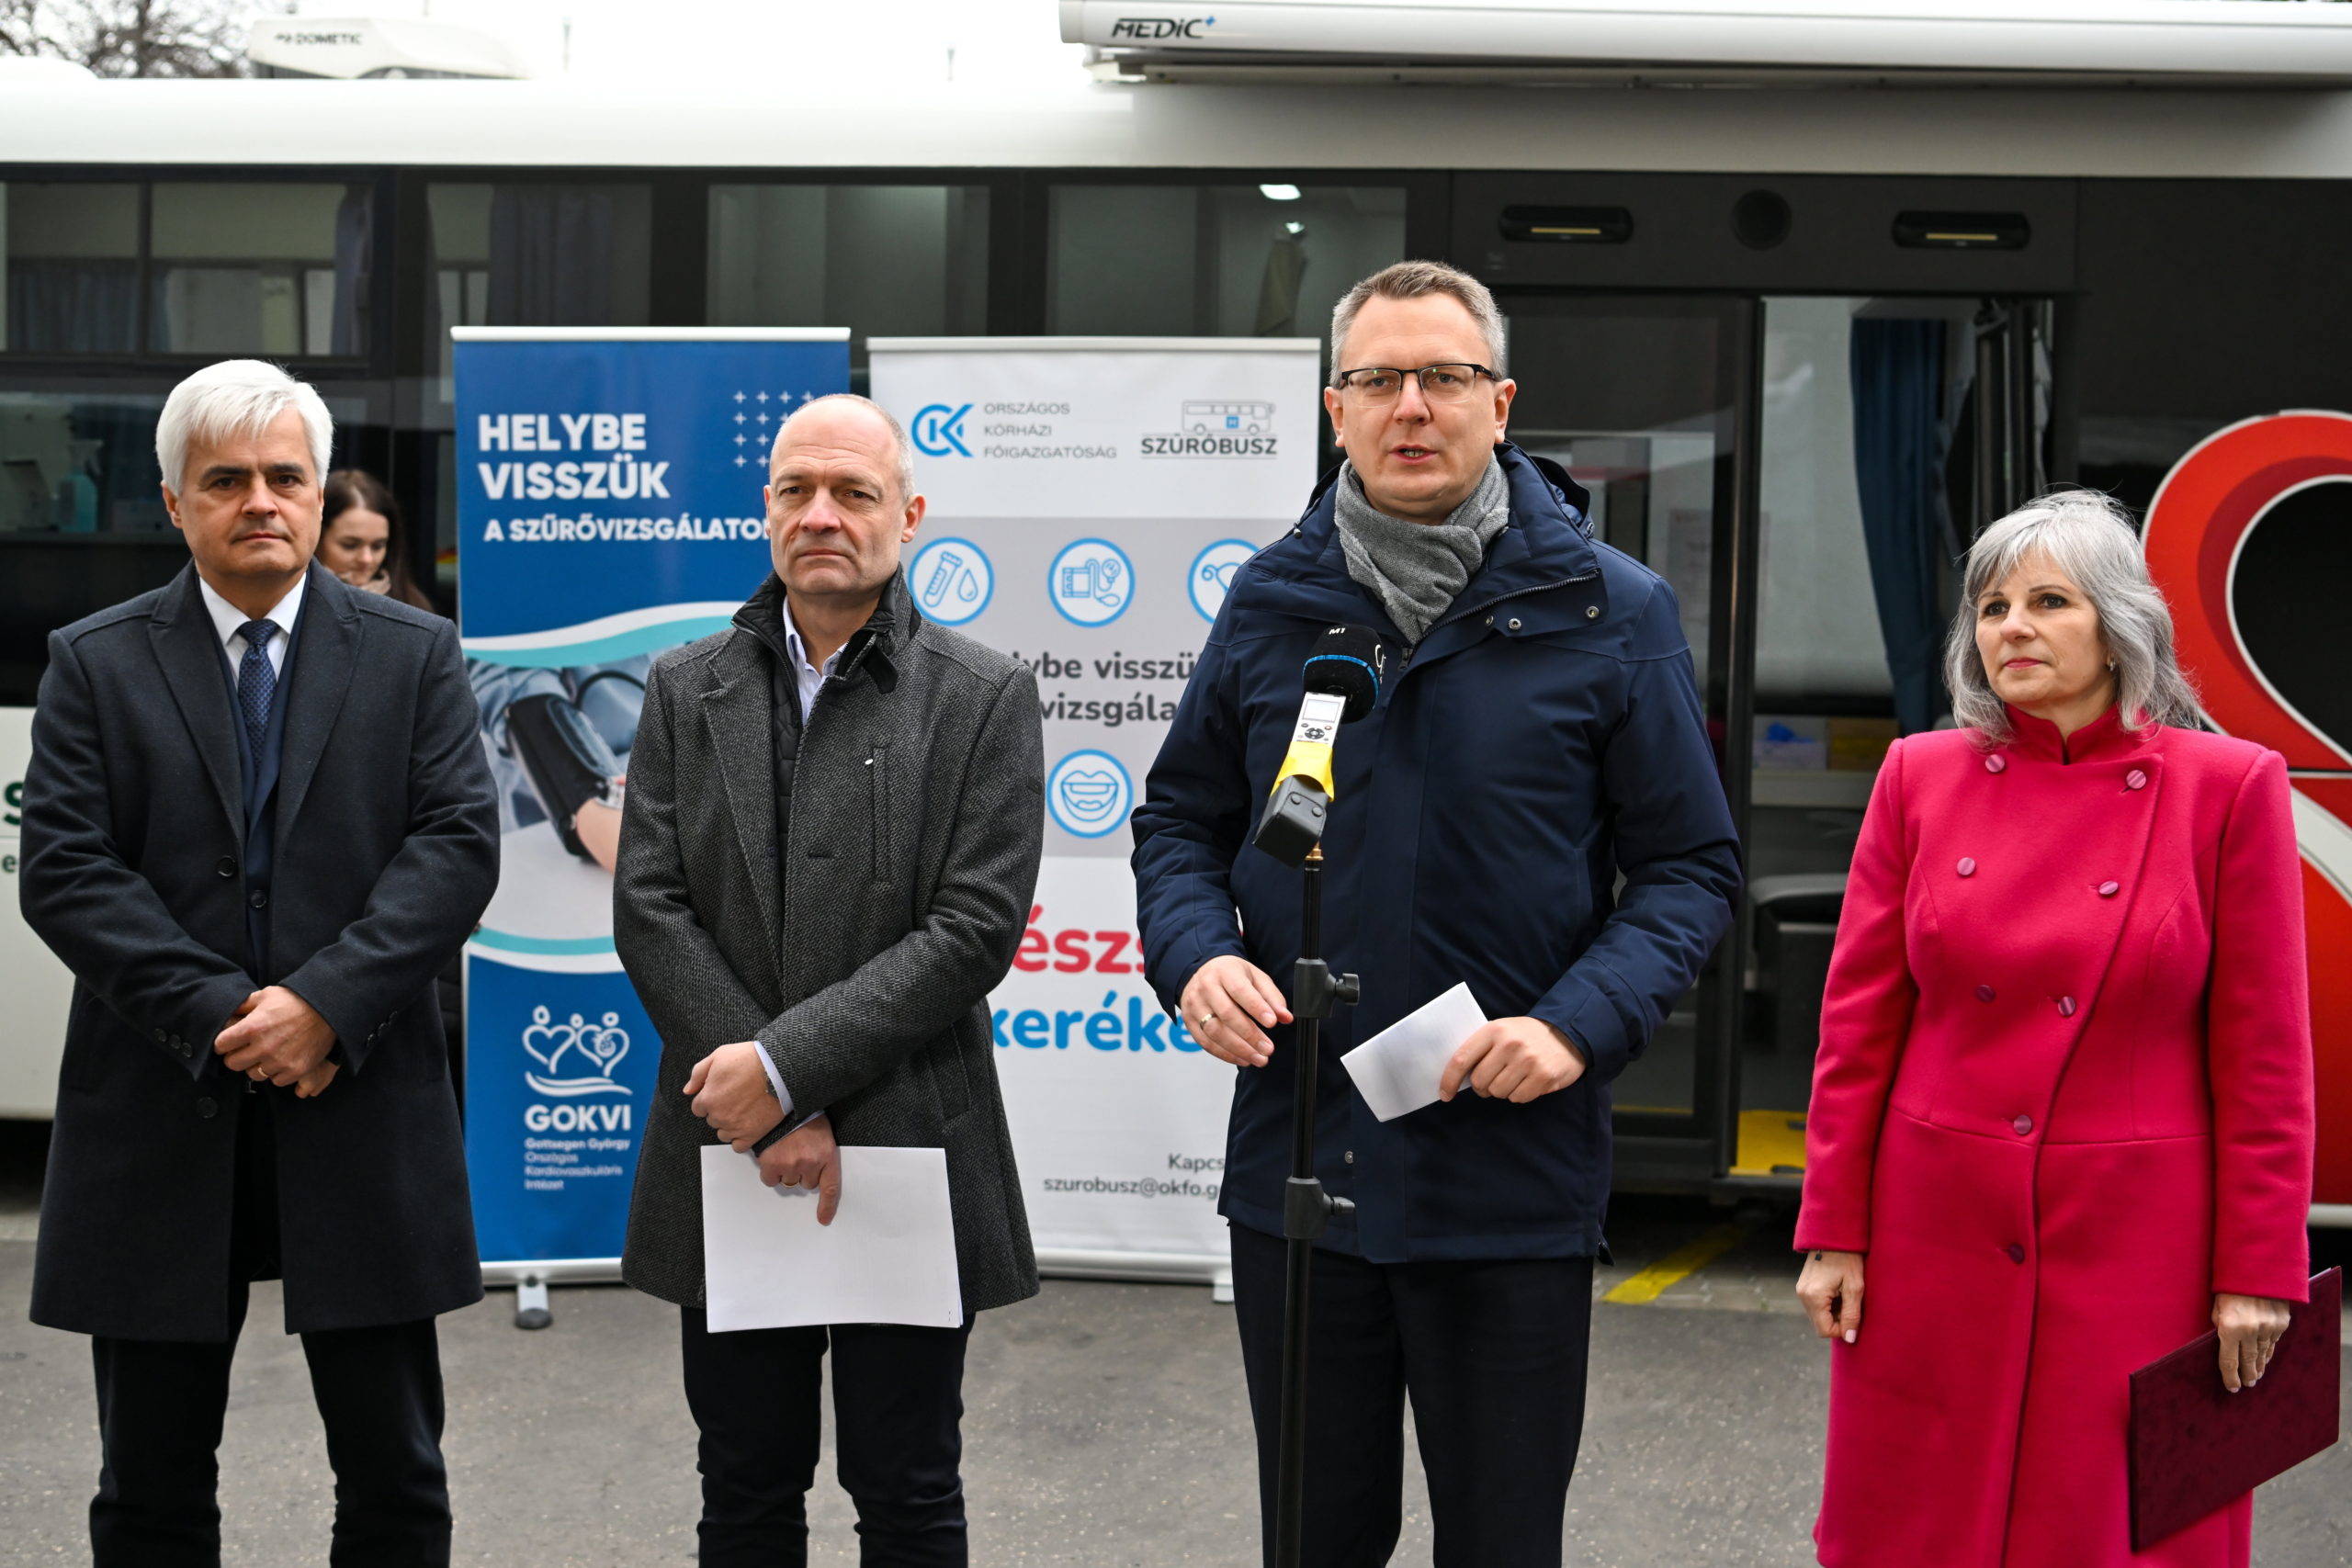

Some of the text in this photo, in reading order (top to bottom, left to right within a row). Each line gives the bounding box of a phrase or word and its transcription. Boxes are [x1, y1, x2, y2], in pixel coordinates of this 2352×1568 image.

[983, 402, 1070, 415] ORSZÁGOS
[479, 414, 647, 451] HELYBE
[984, 423, 1052, 437] KÓRHÁZI
[984, 445, 1117, 459] FŐIGAZGATÓSÁG
[1141, 433, 1278, 455] SZŰRŐBUSZ
[478, 453, 671, 500] VISSZÜK
[483, 519, 504, 541] A
[1329, 626, 1346, 636] M1
[1094, 651, 1198, 680] visszü
[525, 1104, 632, 1132] GOKVI
[1168, 1153, 1226, 1173] Kapcs
[1044, 1177, 1220, 1201] szurobusz@okfo.g
